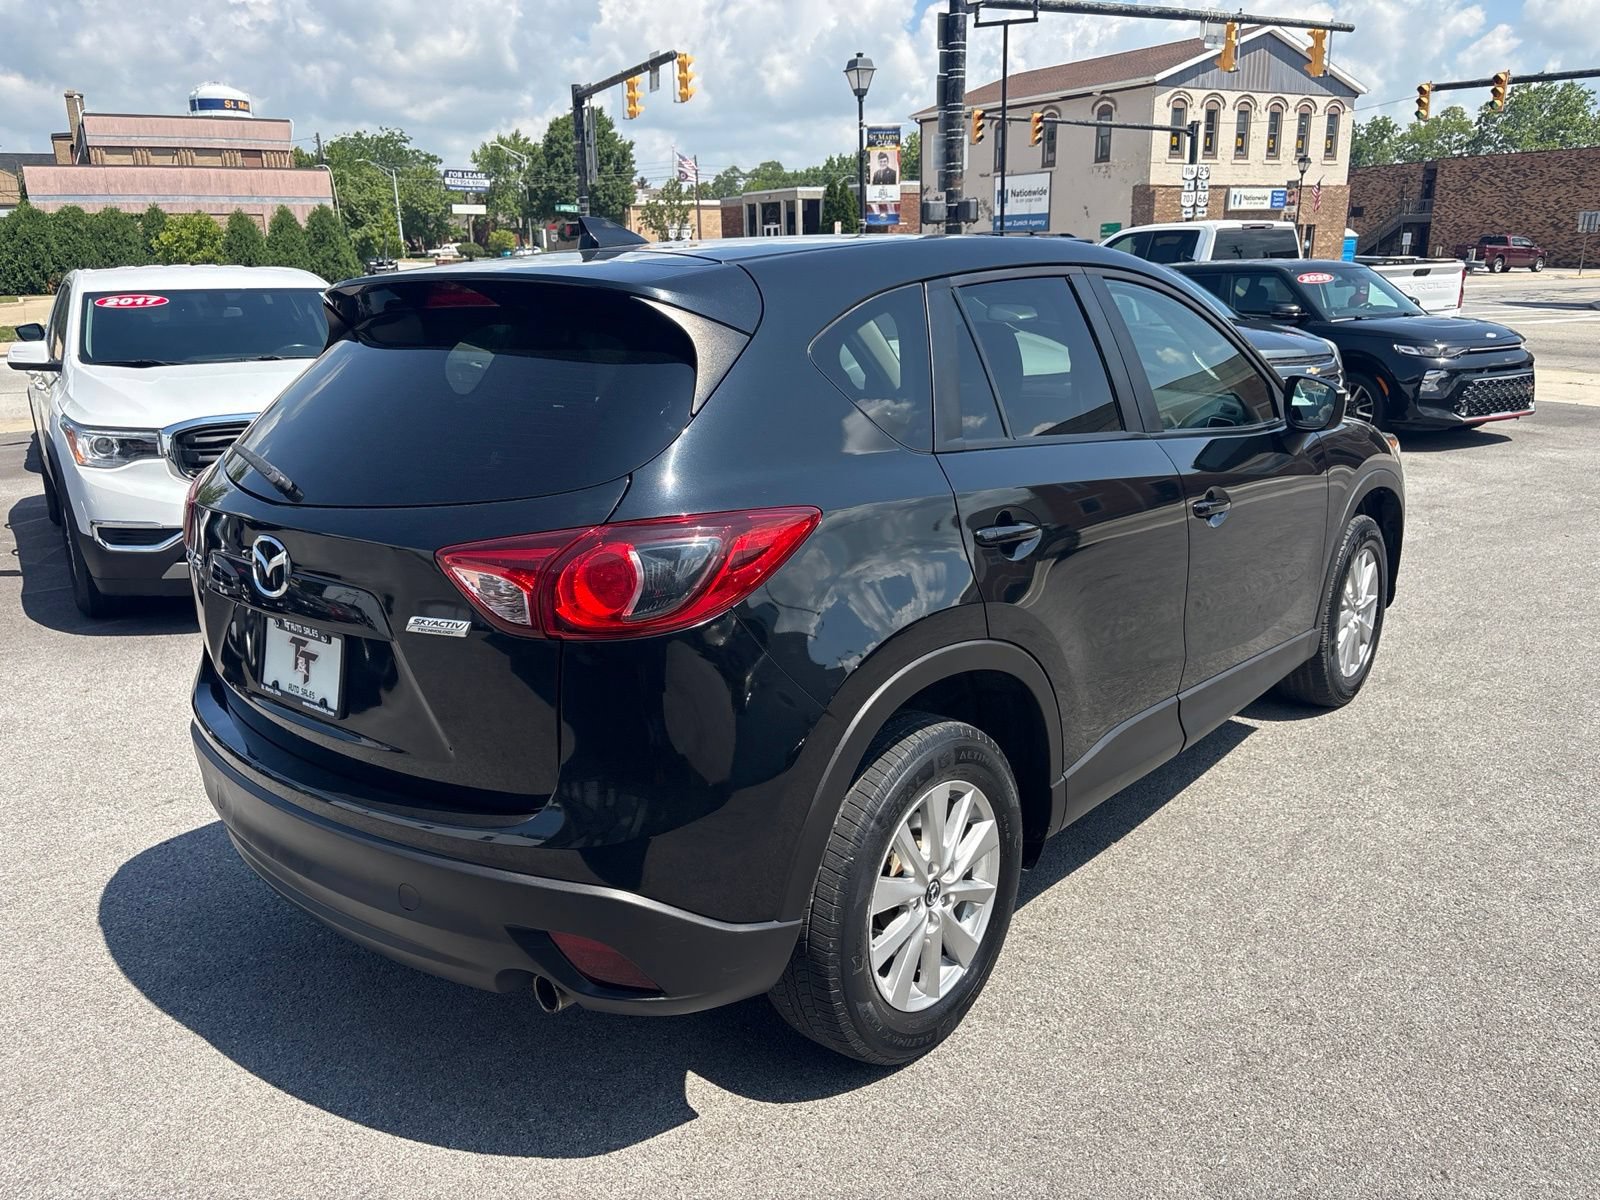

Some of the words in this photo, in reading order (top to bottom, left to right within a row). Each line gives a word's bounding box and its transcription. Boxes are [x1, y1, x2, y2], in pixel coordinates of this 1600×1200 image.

[1184, 166, 1195, 176] 116
[1199, 166, 1210, 176] 29
[1010, 187, 1048, 198] Nationwide
[1183, 194, 1194, 203] 703
[1197, 194, 1207, 203] 66
[1302, 274, 1330, 284] 2020
[103, 297, 161, 307] 2017
[413, 618, 464, 629] SKYACTIV
[291, 622, 302, 633] AUTO
[303, 625, 319, 638] SALES
[417, 627, 456, 635] TECHNOLOGY
[288, 683, 300, 695] AUTO
[300, 687, 316, 700] SALES
